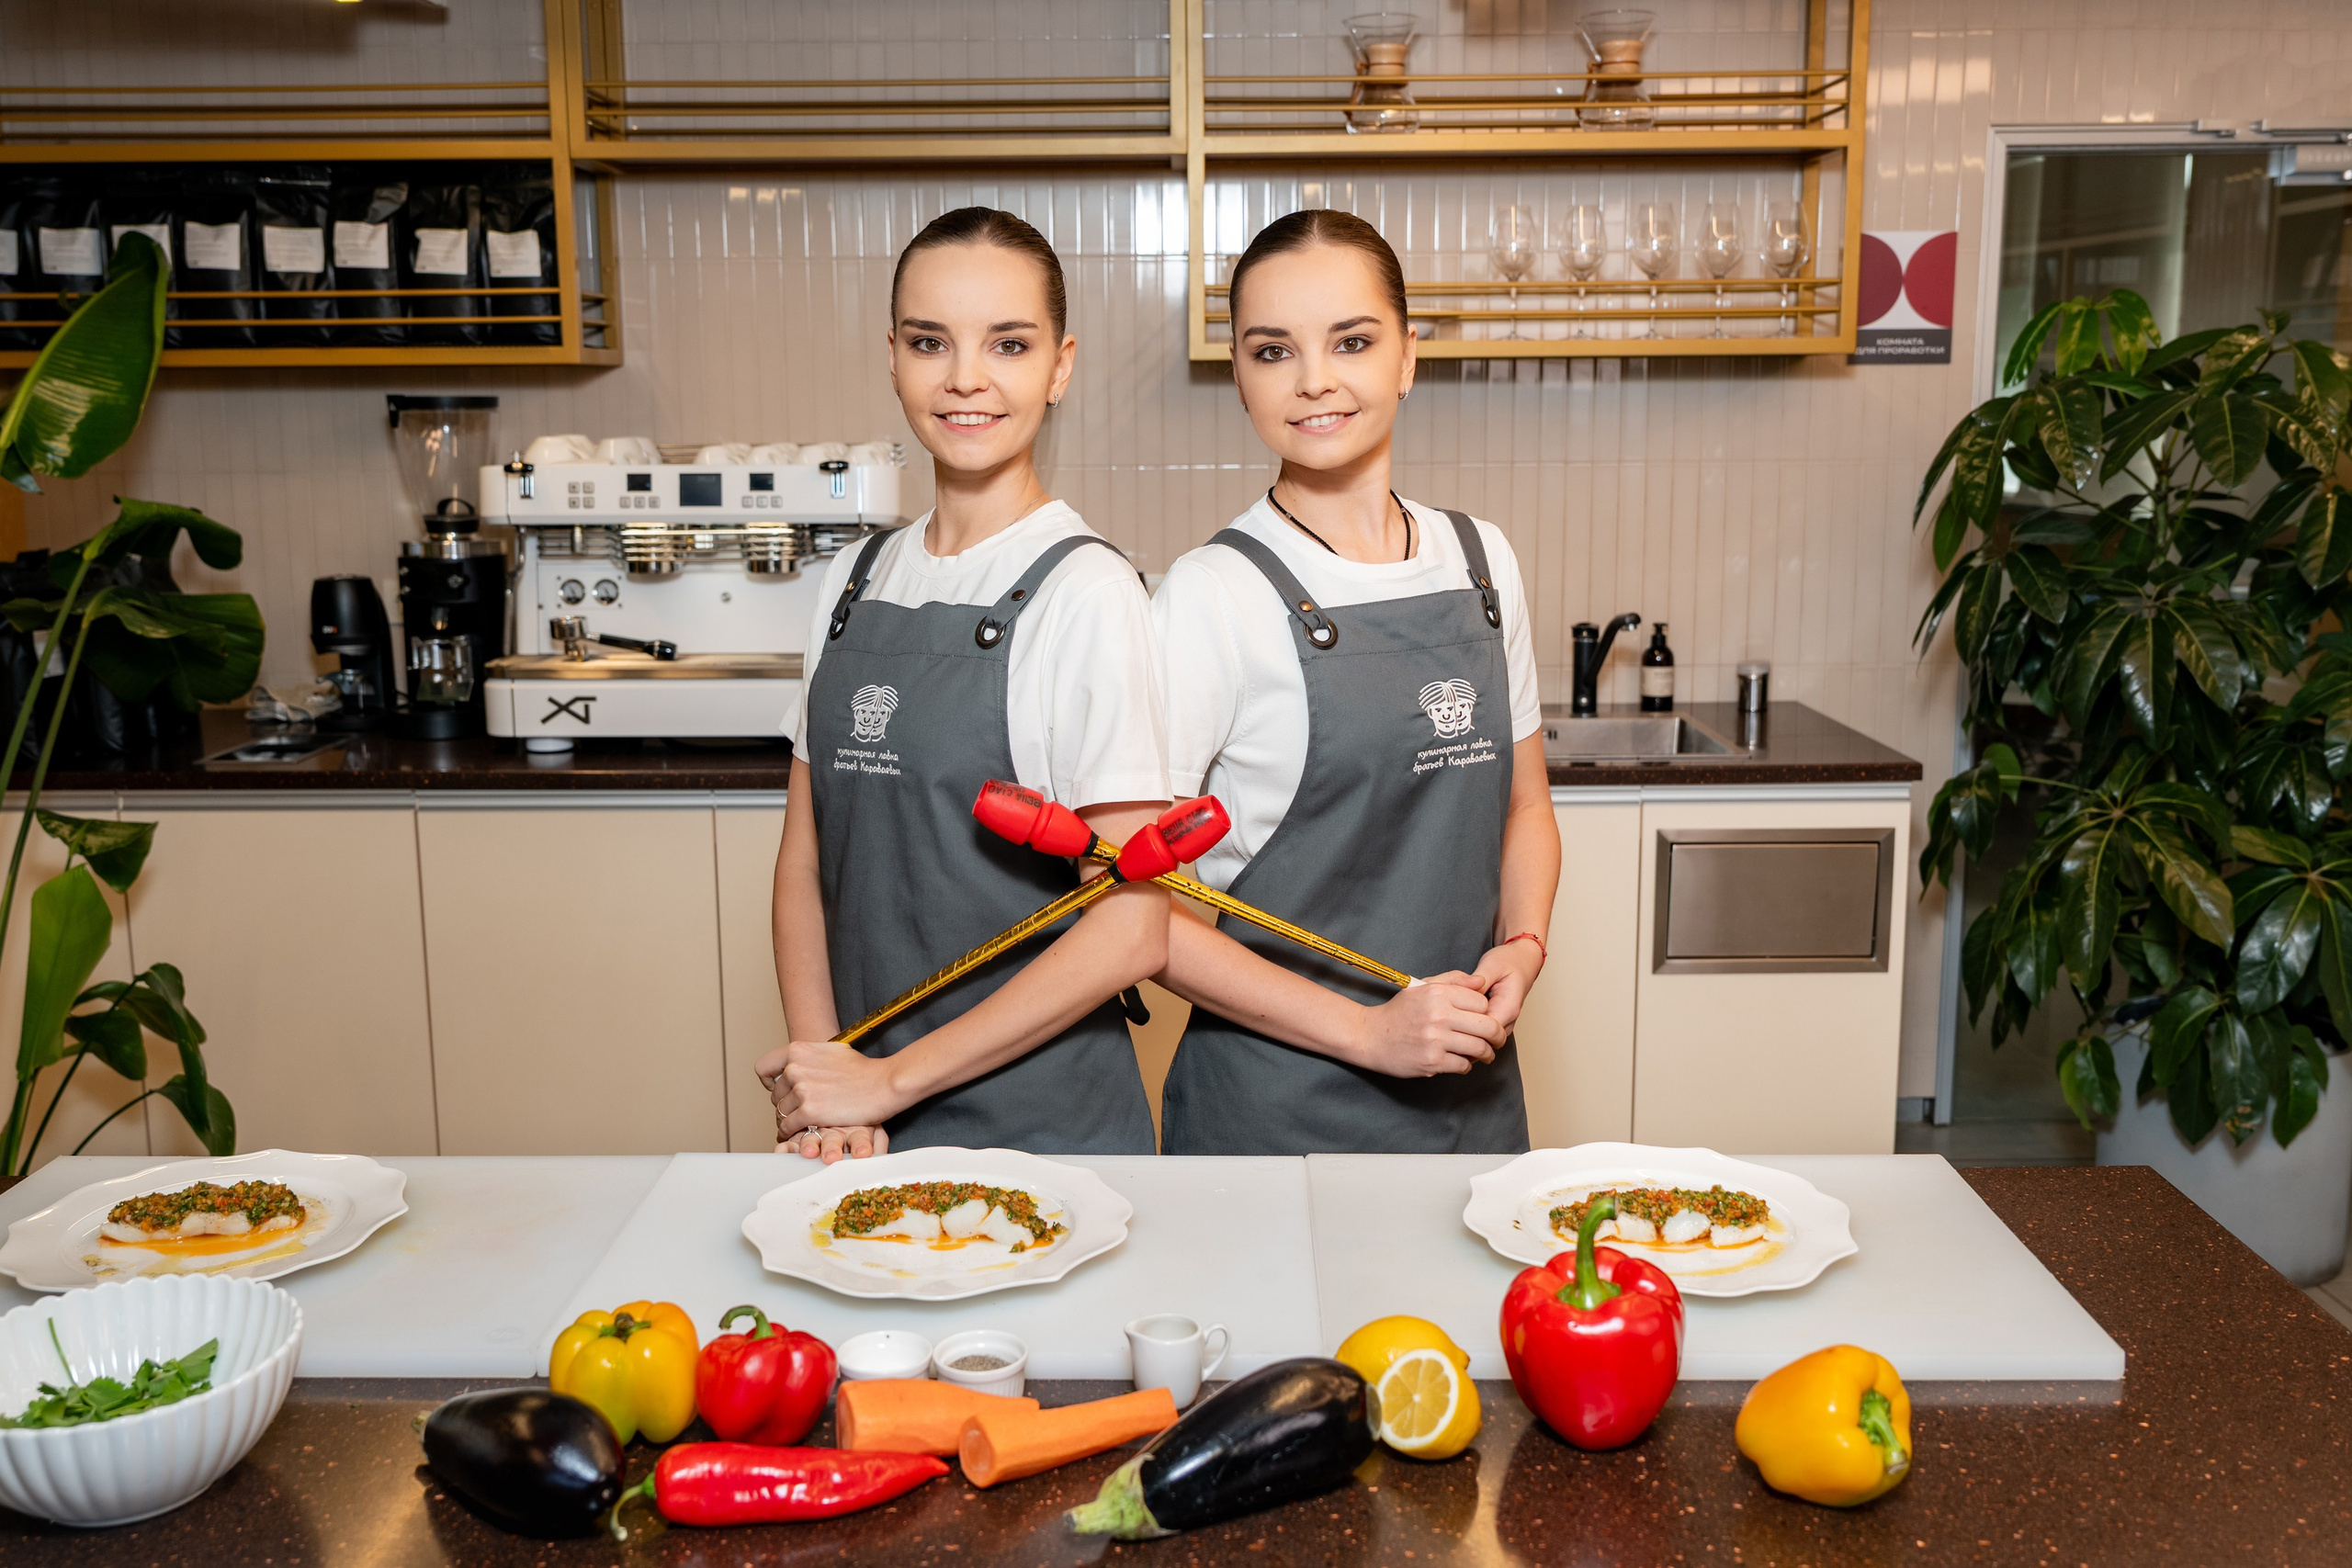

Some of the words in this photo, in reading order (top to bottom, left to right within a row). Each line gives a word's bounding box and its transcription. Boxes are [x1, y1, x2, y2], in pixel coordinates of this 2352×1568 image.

[1876, 337, 1925, 346] КОМНАТА
[1855, 346, 1876, 355] ДЛЯ
[1878, 345, 1945, 355] ПРОРАБОТКИ
[837, 748, 876, 761] кулинарная
[877, 749, 899, 761] лавка
[1417, 743, 1467, 761] кулинарная
[1470, 737, 1493, 750] лавка
[833, 758, 858, 772] братьев
[860, 760, 901, 776] Караваевых
[1412, 757, 1444, 775] братьев
[1448, 750, 1497, 769] Караваевых
[988, 784, 1013, 797] CIAO
